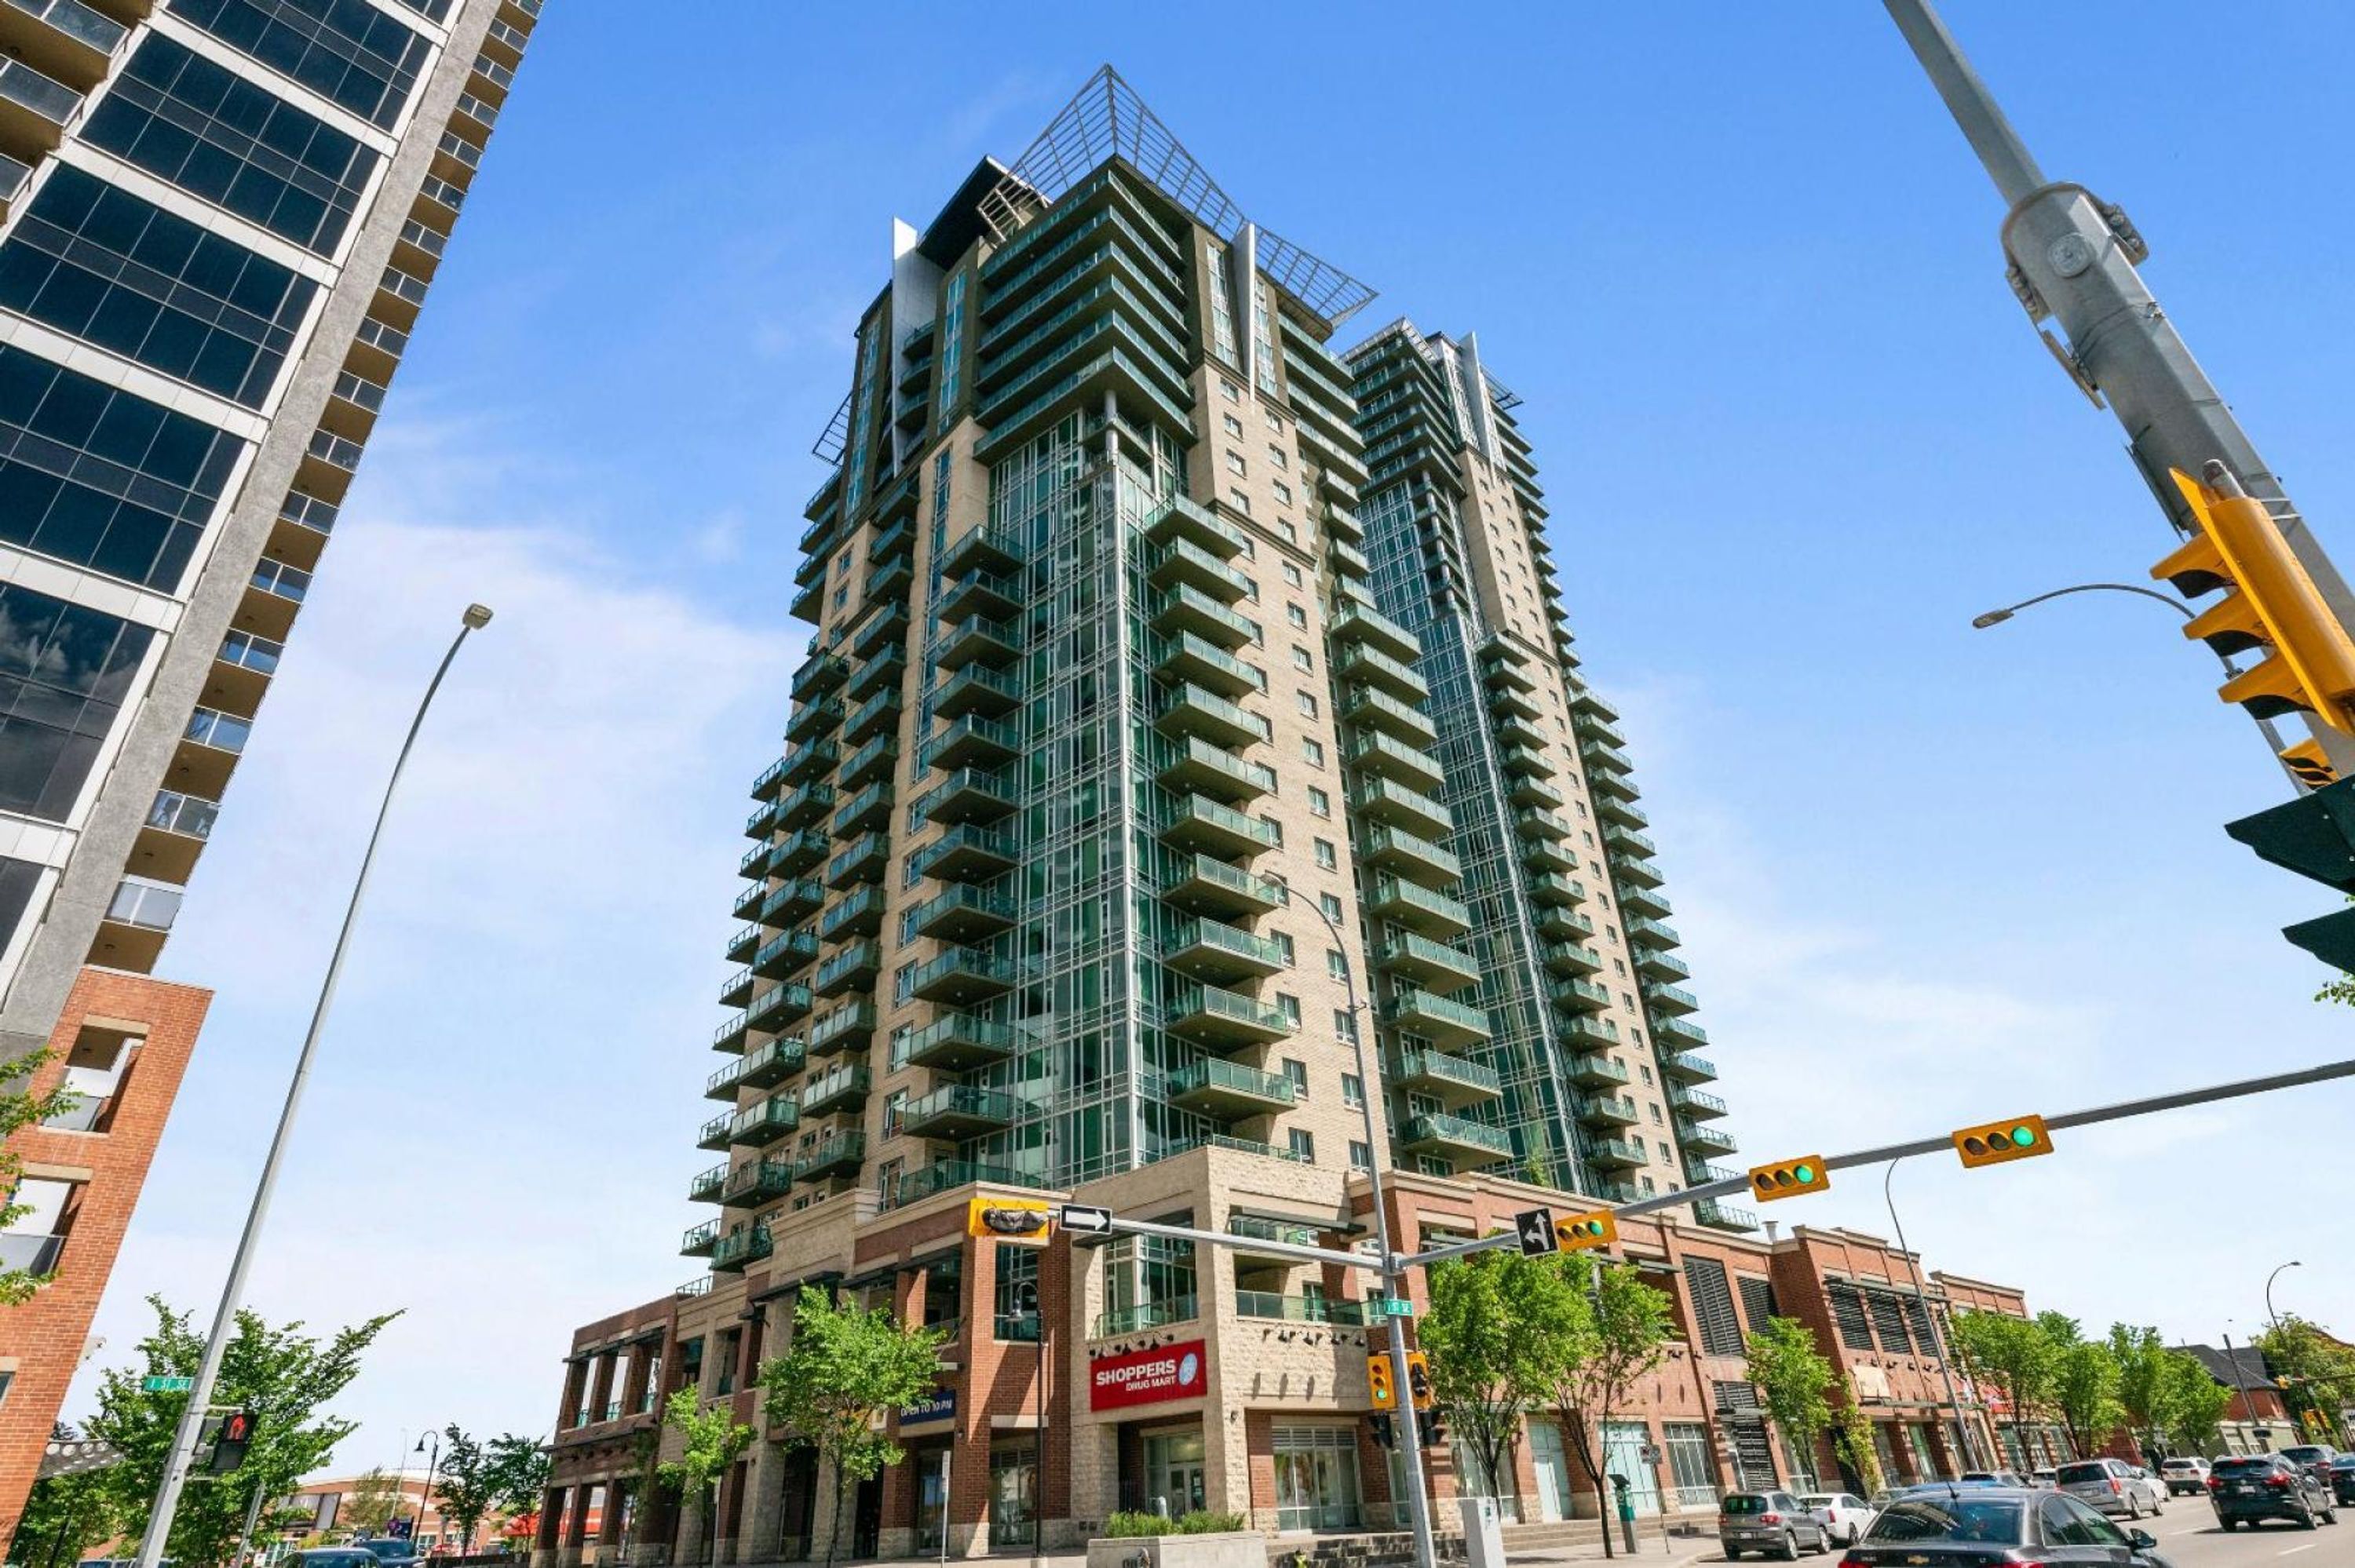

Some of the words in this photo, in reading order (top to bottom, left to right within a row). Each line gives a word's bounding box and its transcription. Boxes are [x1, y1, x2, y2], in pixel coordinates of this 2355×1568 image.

[1096, 1359, 1177, 1386] SHOPPERS
[161, 1378, 172, 1390] ST
[1126, 1380, 1150, 1391] DRUG
[1152, 1375, 1176, 1387] MART
[921, 1402, 930, 1413] TO
[941, 1398, 952, 1410] PM
